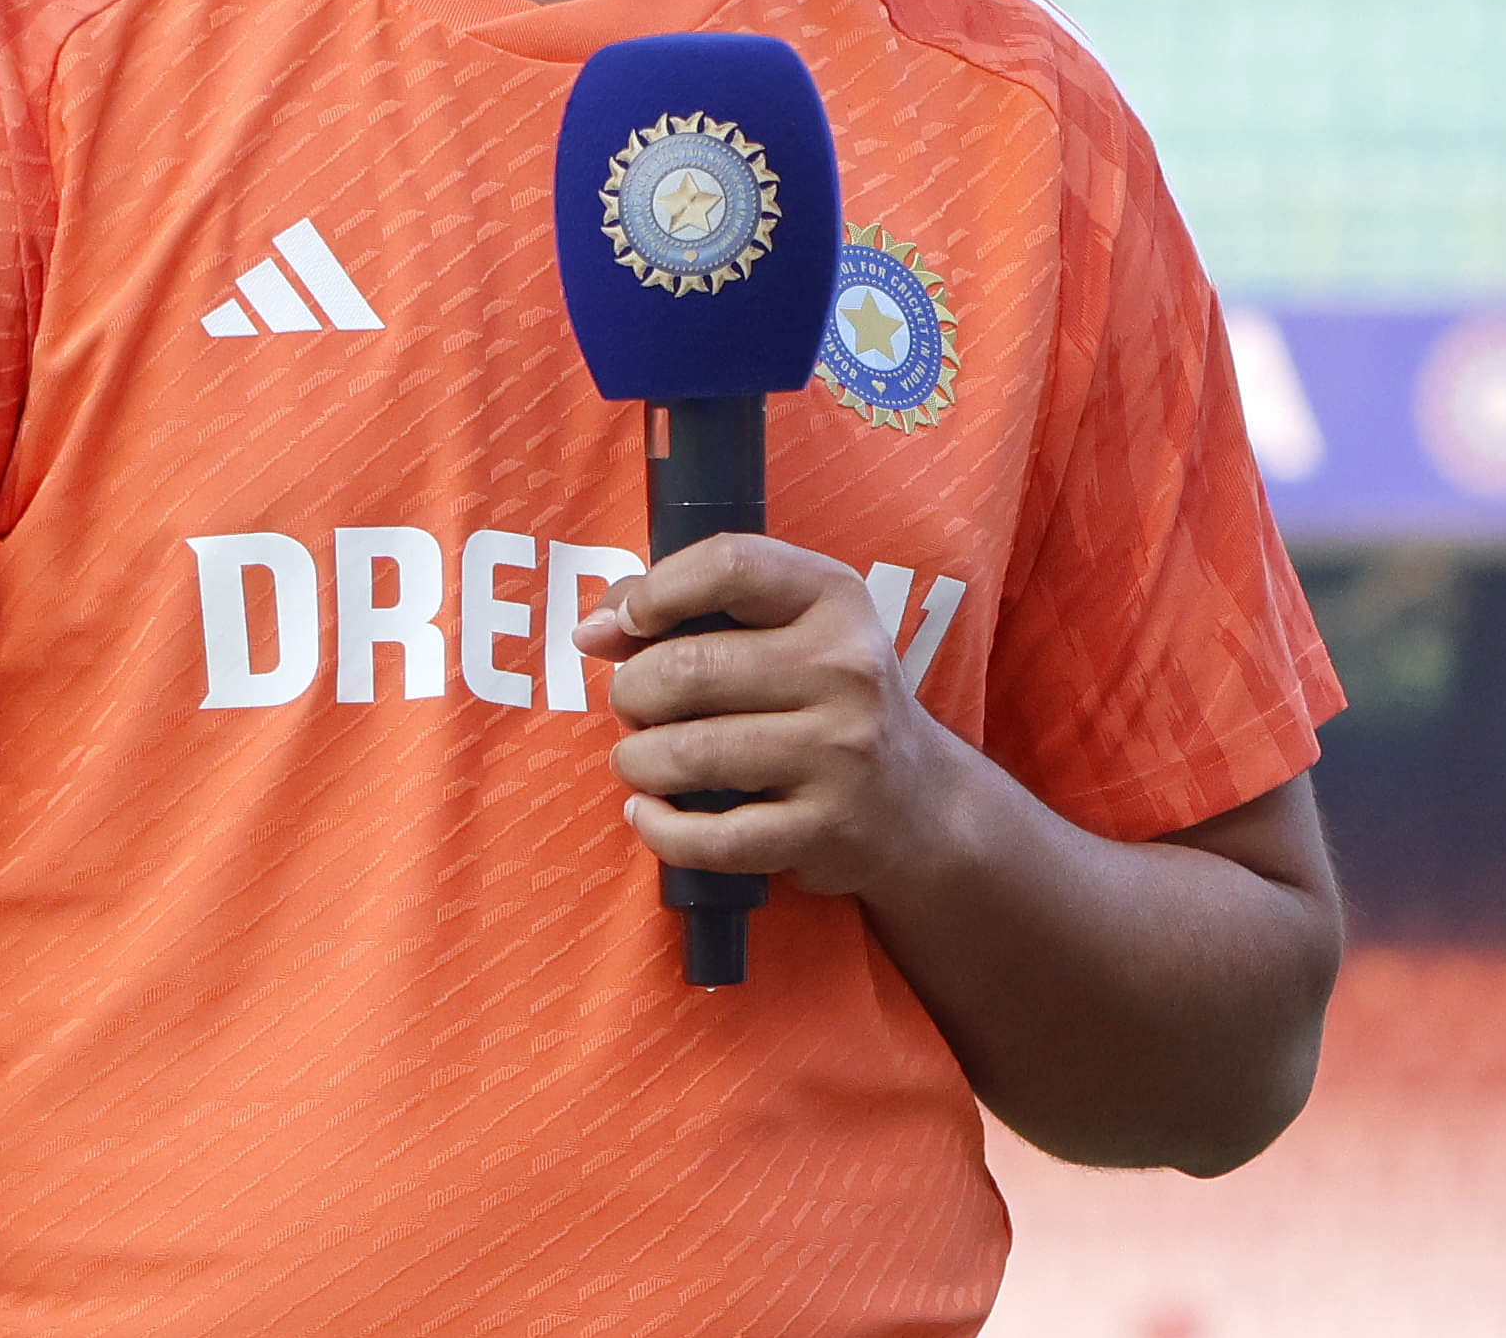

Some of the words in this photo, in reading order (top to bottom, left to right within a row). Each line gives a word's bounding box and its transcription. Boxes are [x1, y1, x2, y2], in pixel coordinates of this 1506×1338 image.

[860, 261, 887, 279] FOR
[891, 275, 930, 335] CRICKET
[920, 340, 931, 358] IN
[899, 360, 928, 392] INDIA
